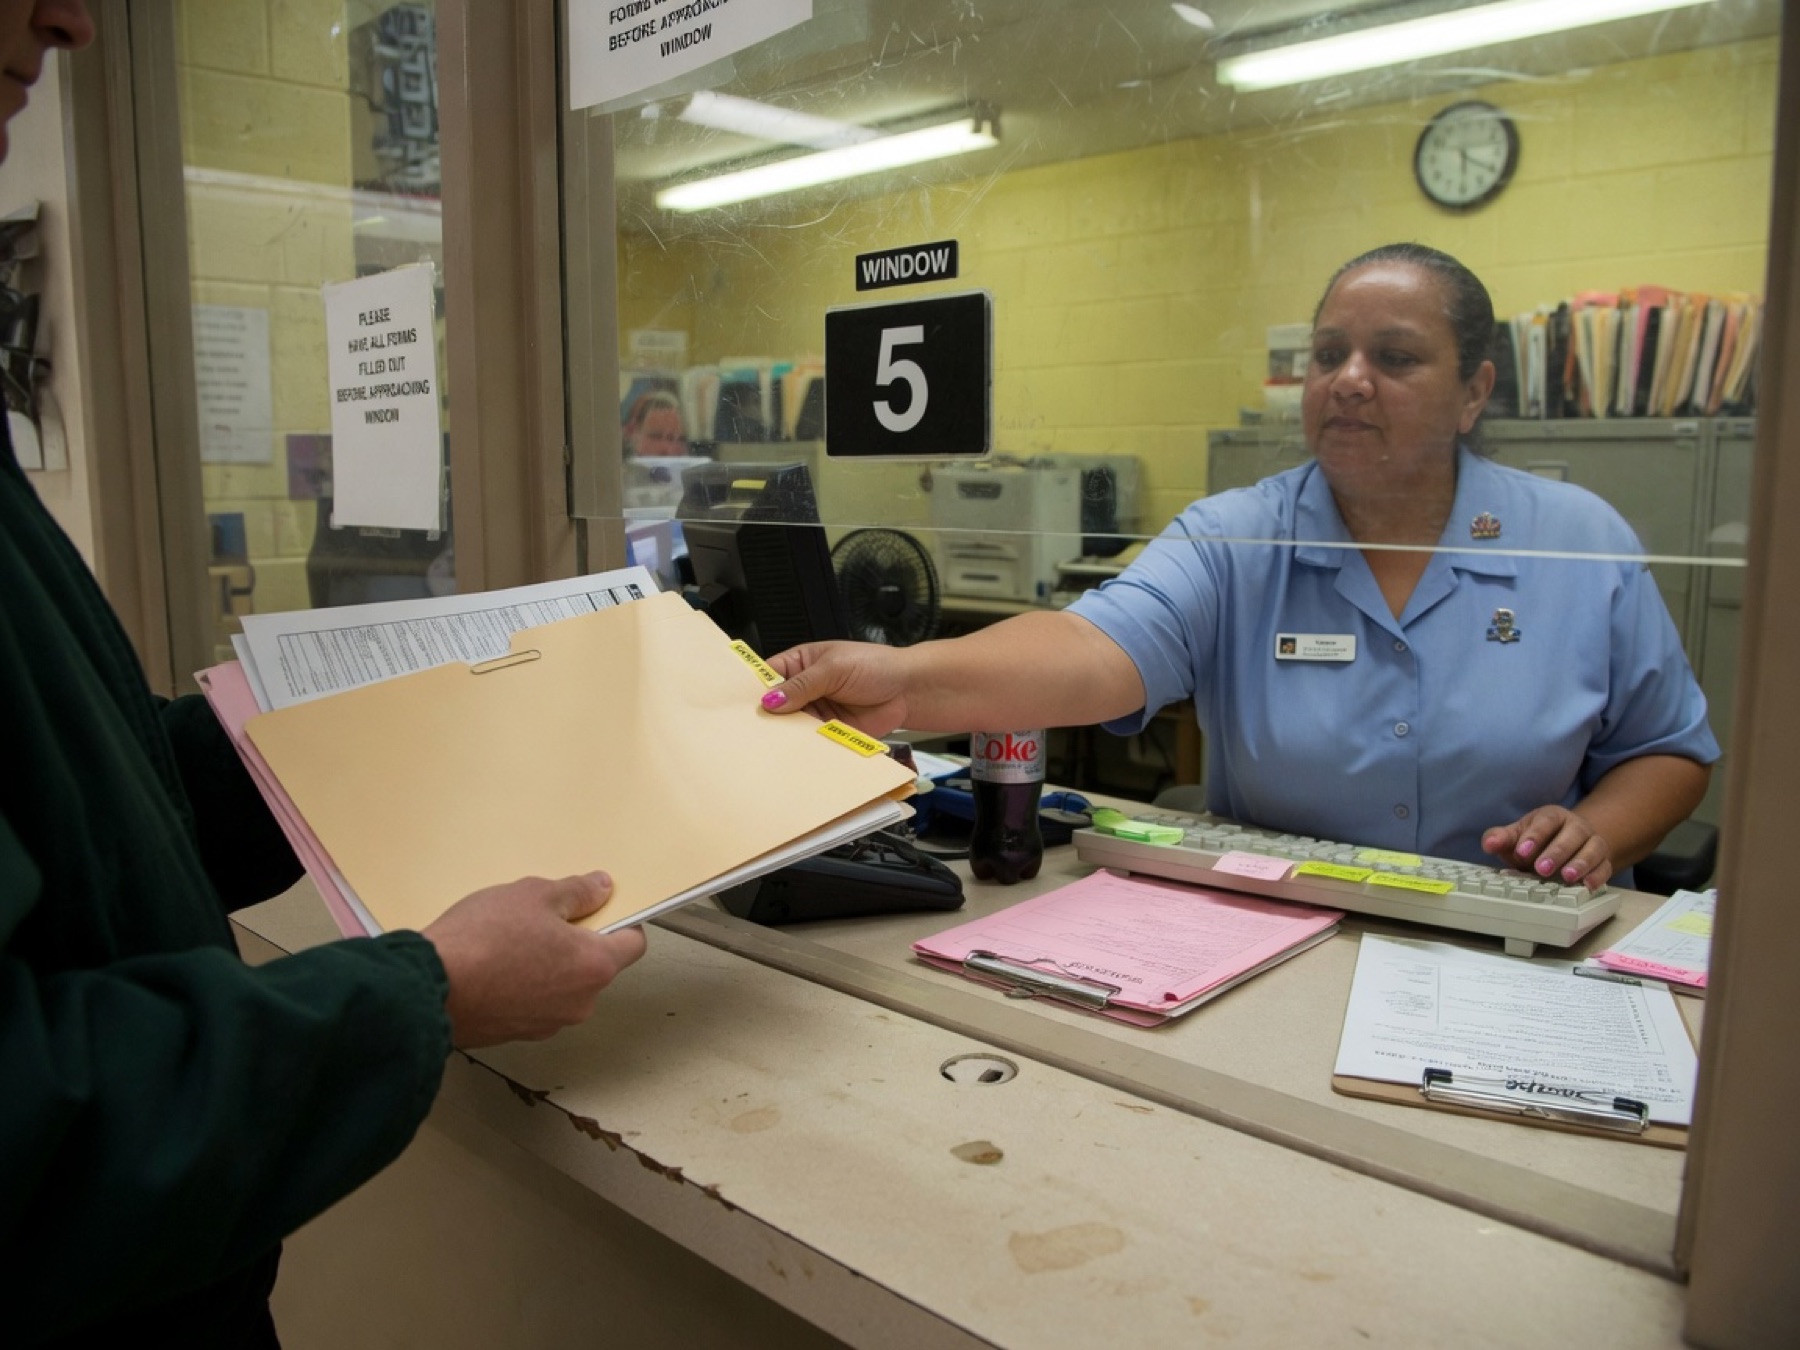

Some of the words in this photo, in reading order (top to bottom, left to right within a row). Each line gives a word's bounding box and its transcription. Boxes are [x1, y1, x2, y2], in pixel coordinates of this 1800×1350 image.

[660, 23, 713, 57] WINDOW
[862, 247, 950, 284] WINDOW
[388, 355, 406, 373] OUT
[872, 324, 929, 433] 5
